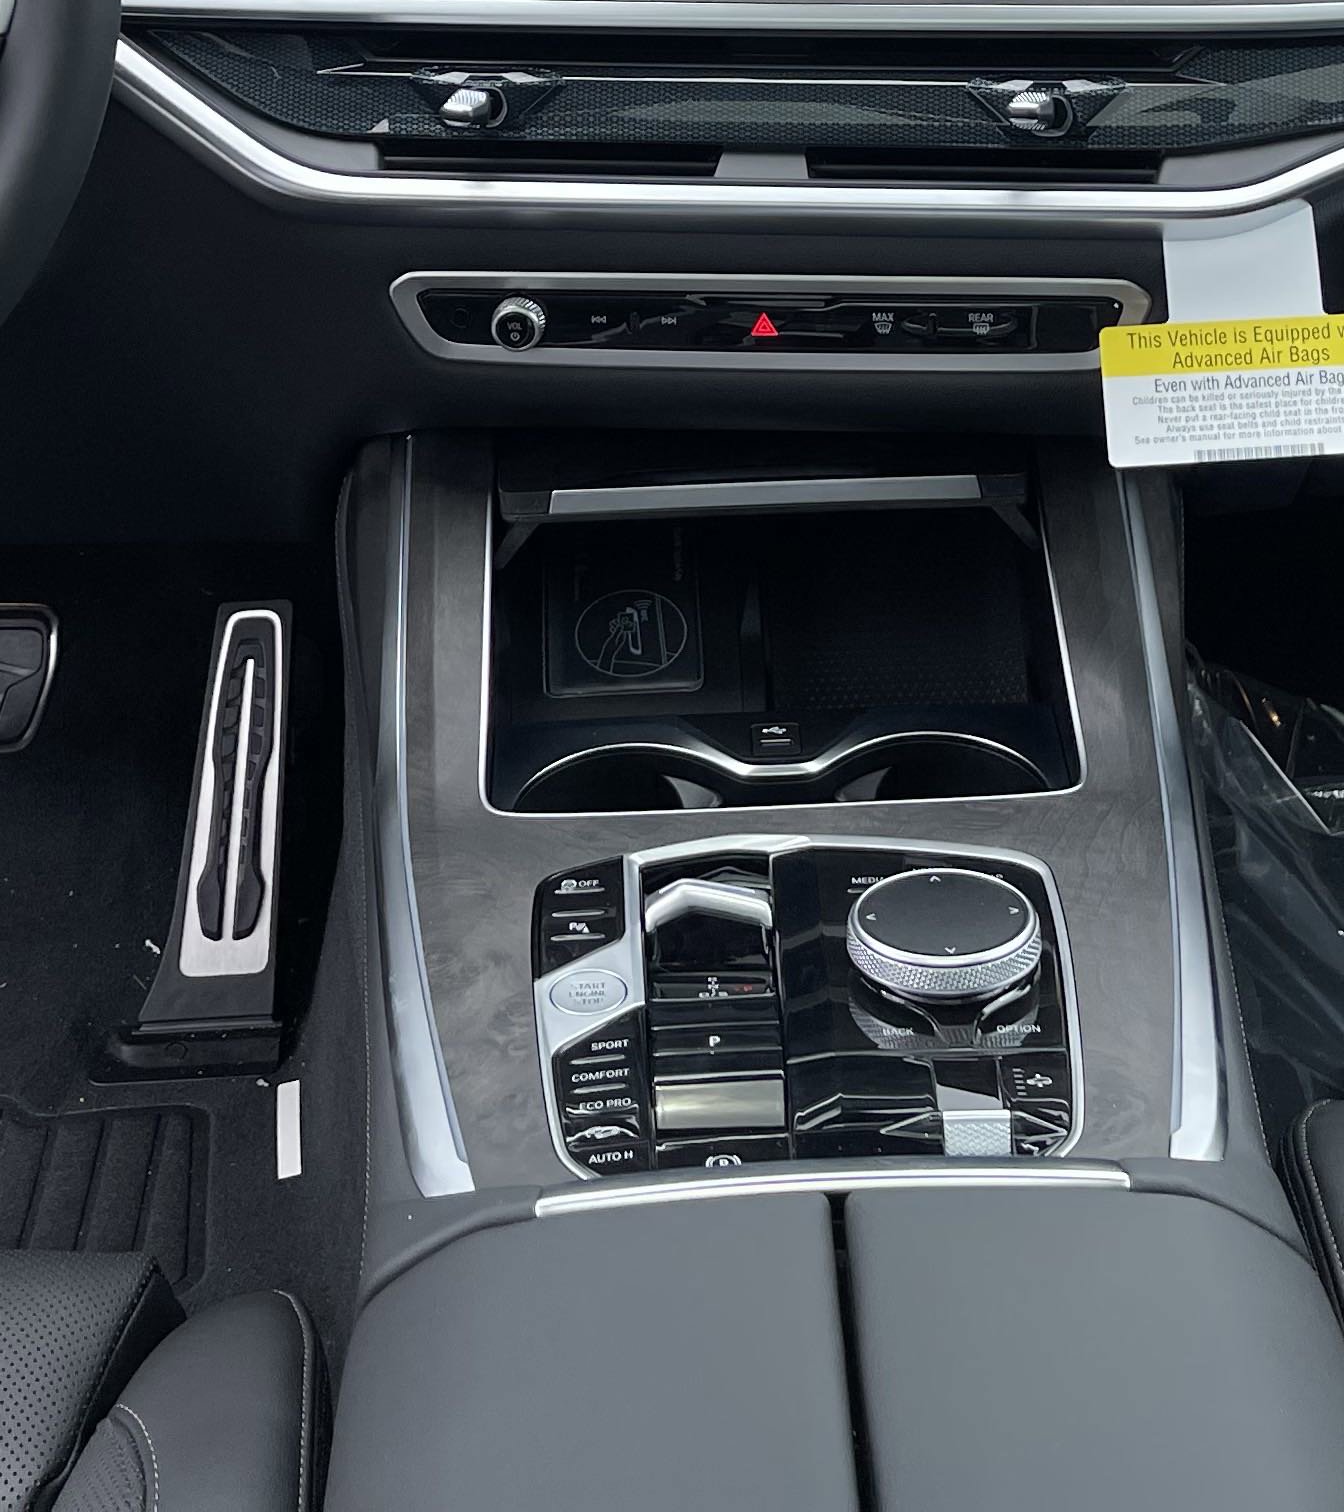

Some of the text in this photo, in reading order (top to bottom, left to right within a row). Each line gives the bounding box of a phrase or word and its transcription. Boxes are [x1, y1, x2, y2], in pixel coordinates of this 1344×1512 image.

[872, 312, 894, 322] MAX
[968, 313, 994, 322] REAR
[1127, 332, 1162, 349] This
[1168, 328, 1227, 347] Vehicle
[1233, 328, 1247, 344] is
[1253, 323, 1331, 345] Equipped
[1173, 346, 1330, 369] Advanced Air Bags
[1154, 378, 1186, 393] Even
[1191, 376, 1219, 391] with
[1224, 371, 1290, 389] Advanced
[1296, 371, 1314, 385] Air
[1132, 396, 1168, 406] Children
[1189, 394, 1199, 402] be
[1202, 392, 1224, 401] killed
[1239, 390, 1279, 400] seriously
[1281, 389, 1312, 399] injured
[1314, 388, 1325, 397] by
[1328, 386, 1342, 394] the
[1158, 405, 1173, 414] The
[1176, 404, 1196, 413] back
[1199, 403, 1216, 412] seat
[1230, 402, 1243, 410] the
[1246, 400, 1271, 409] safest
[1275, 400, 1296, 409] place
[1301, 398, 1312, 406] for
[1157, 415, 1182, 424] Never
[1185, 414, 1199, 423] put
[1210, 411, 1256, 421] rear-facing
[1259, 410, 1280, 418] child
[1283, 408, 1301, 416] seat
[1304, 407, 1312, 415] in
[1314, 407, 1329, 415] the
[1166, 424, 1196, 434] Always
[1217, 421, 1234, 430] seat
[1238, 420, 1258, 429] belts
[1262, 420, 1276, 428] and
[1280, 418, 1301, 426] child
[1135, 436, 1150, 445] See
[1153, 434, 1186, 444] owner's
[1189, 431, 1220, 441] manual
[1223, 431, 1235, 439] for
[1239, 429, 1261, 438] more
[1264, 427, 1314, 437] information
[1317, 425, 1342, 434] about
[578, 879, 600, 887] OFF
[883, 1027, 914, 1036] BACK
[996, 1024, 1041, 1033] OPTION
[591, 1039, 630, 1052] SPORT
[709, 1035, 721, 1047] P
[571, 1068, 630, 1083] COMFORT
[579, 1097, 632, 1111] ECO PRO
[588, 1150, 634, 1165] AUTO H
